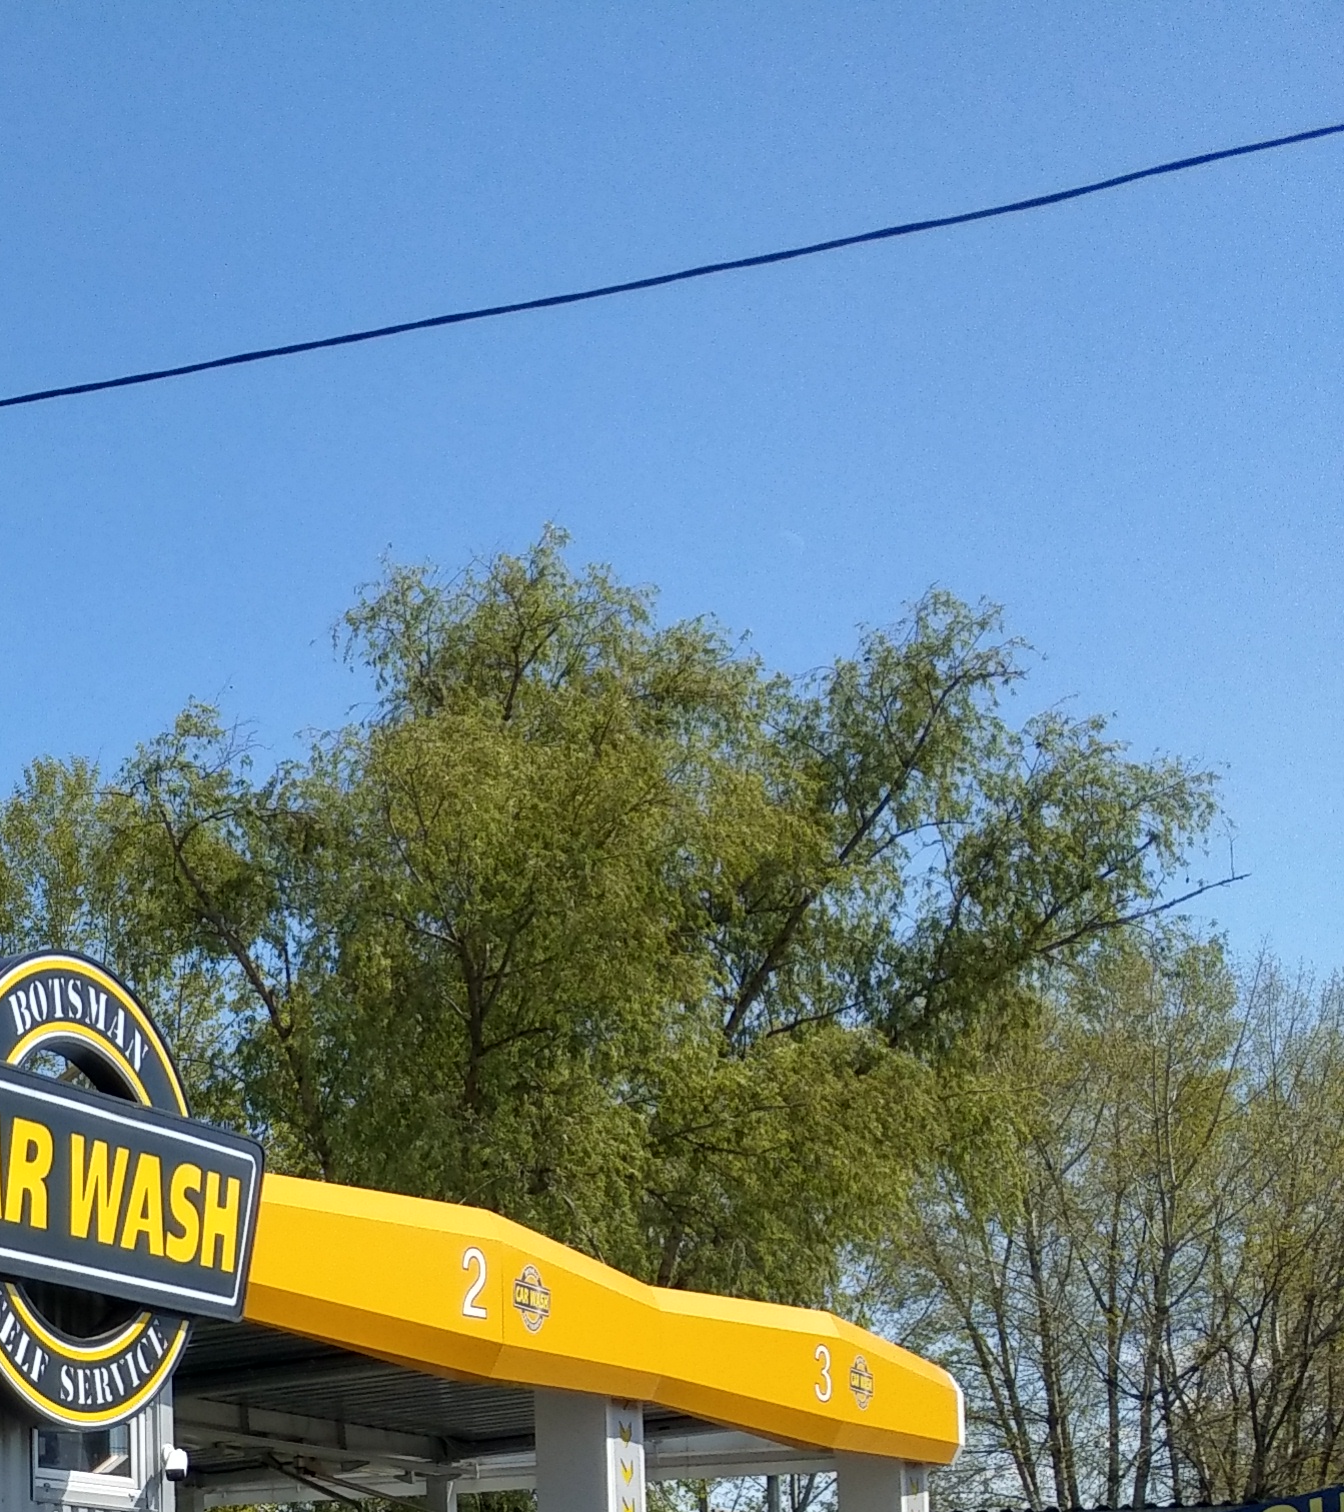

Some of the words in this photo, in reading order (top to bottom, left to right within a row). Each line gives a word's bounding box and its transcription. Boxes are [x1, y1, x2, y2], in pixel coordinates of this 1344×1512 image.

[9, 977, 151, 1075] BOTSMAN
[69, 1132, 241, 1274] WASH
[461, 1246, 488, 1320] 2
[515, 1285, 530, 1306] CAR
[530, 1289, 549, 1311] WASH
[59, 1318, 173, 1406] SERVICE
[814, 1344, 832, 1403] 3
